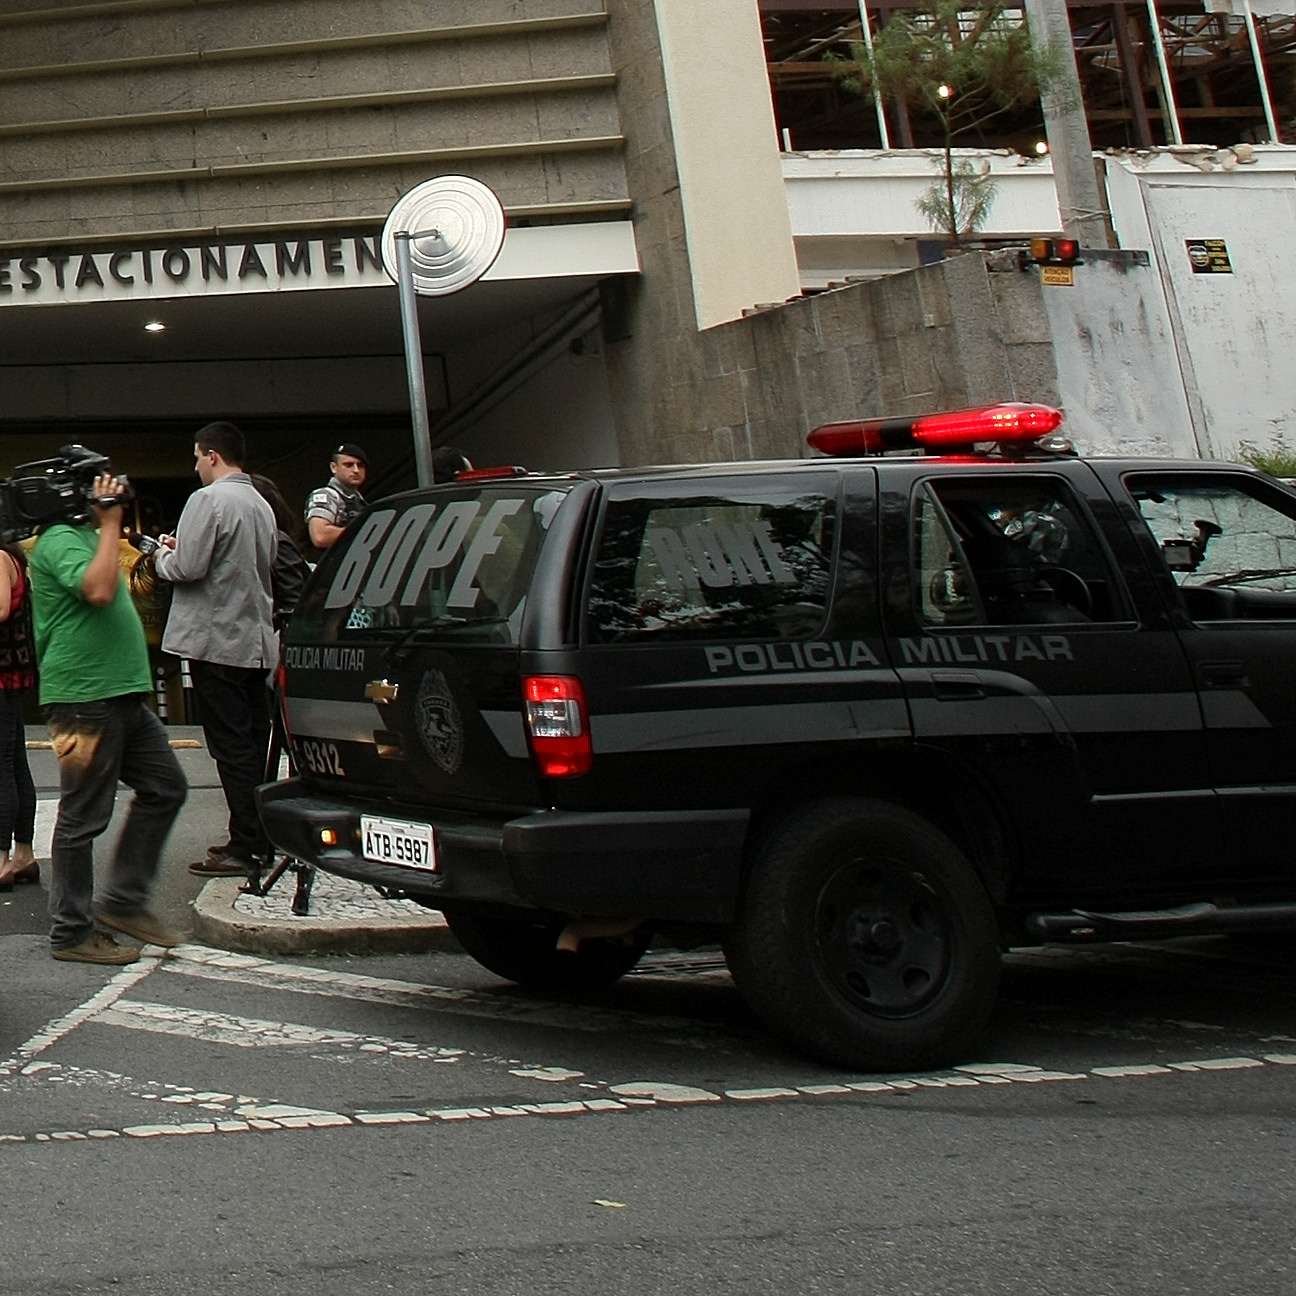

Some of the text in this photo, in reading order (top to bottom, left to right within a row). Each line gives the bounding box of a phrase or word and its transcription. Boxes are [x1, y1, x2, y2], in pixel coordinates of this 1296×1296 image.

[324, 498, 525, 609] BOPE
[647, 521, 799, 590] RONE
[322, 647, 365, 672] MILITAR
[705, 635, 1075, 672] POLICIA MILITAR
[303, 740, 346, 777] 9312
